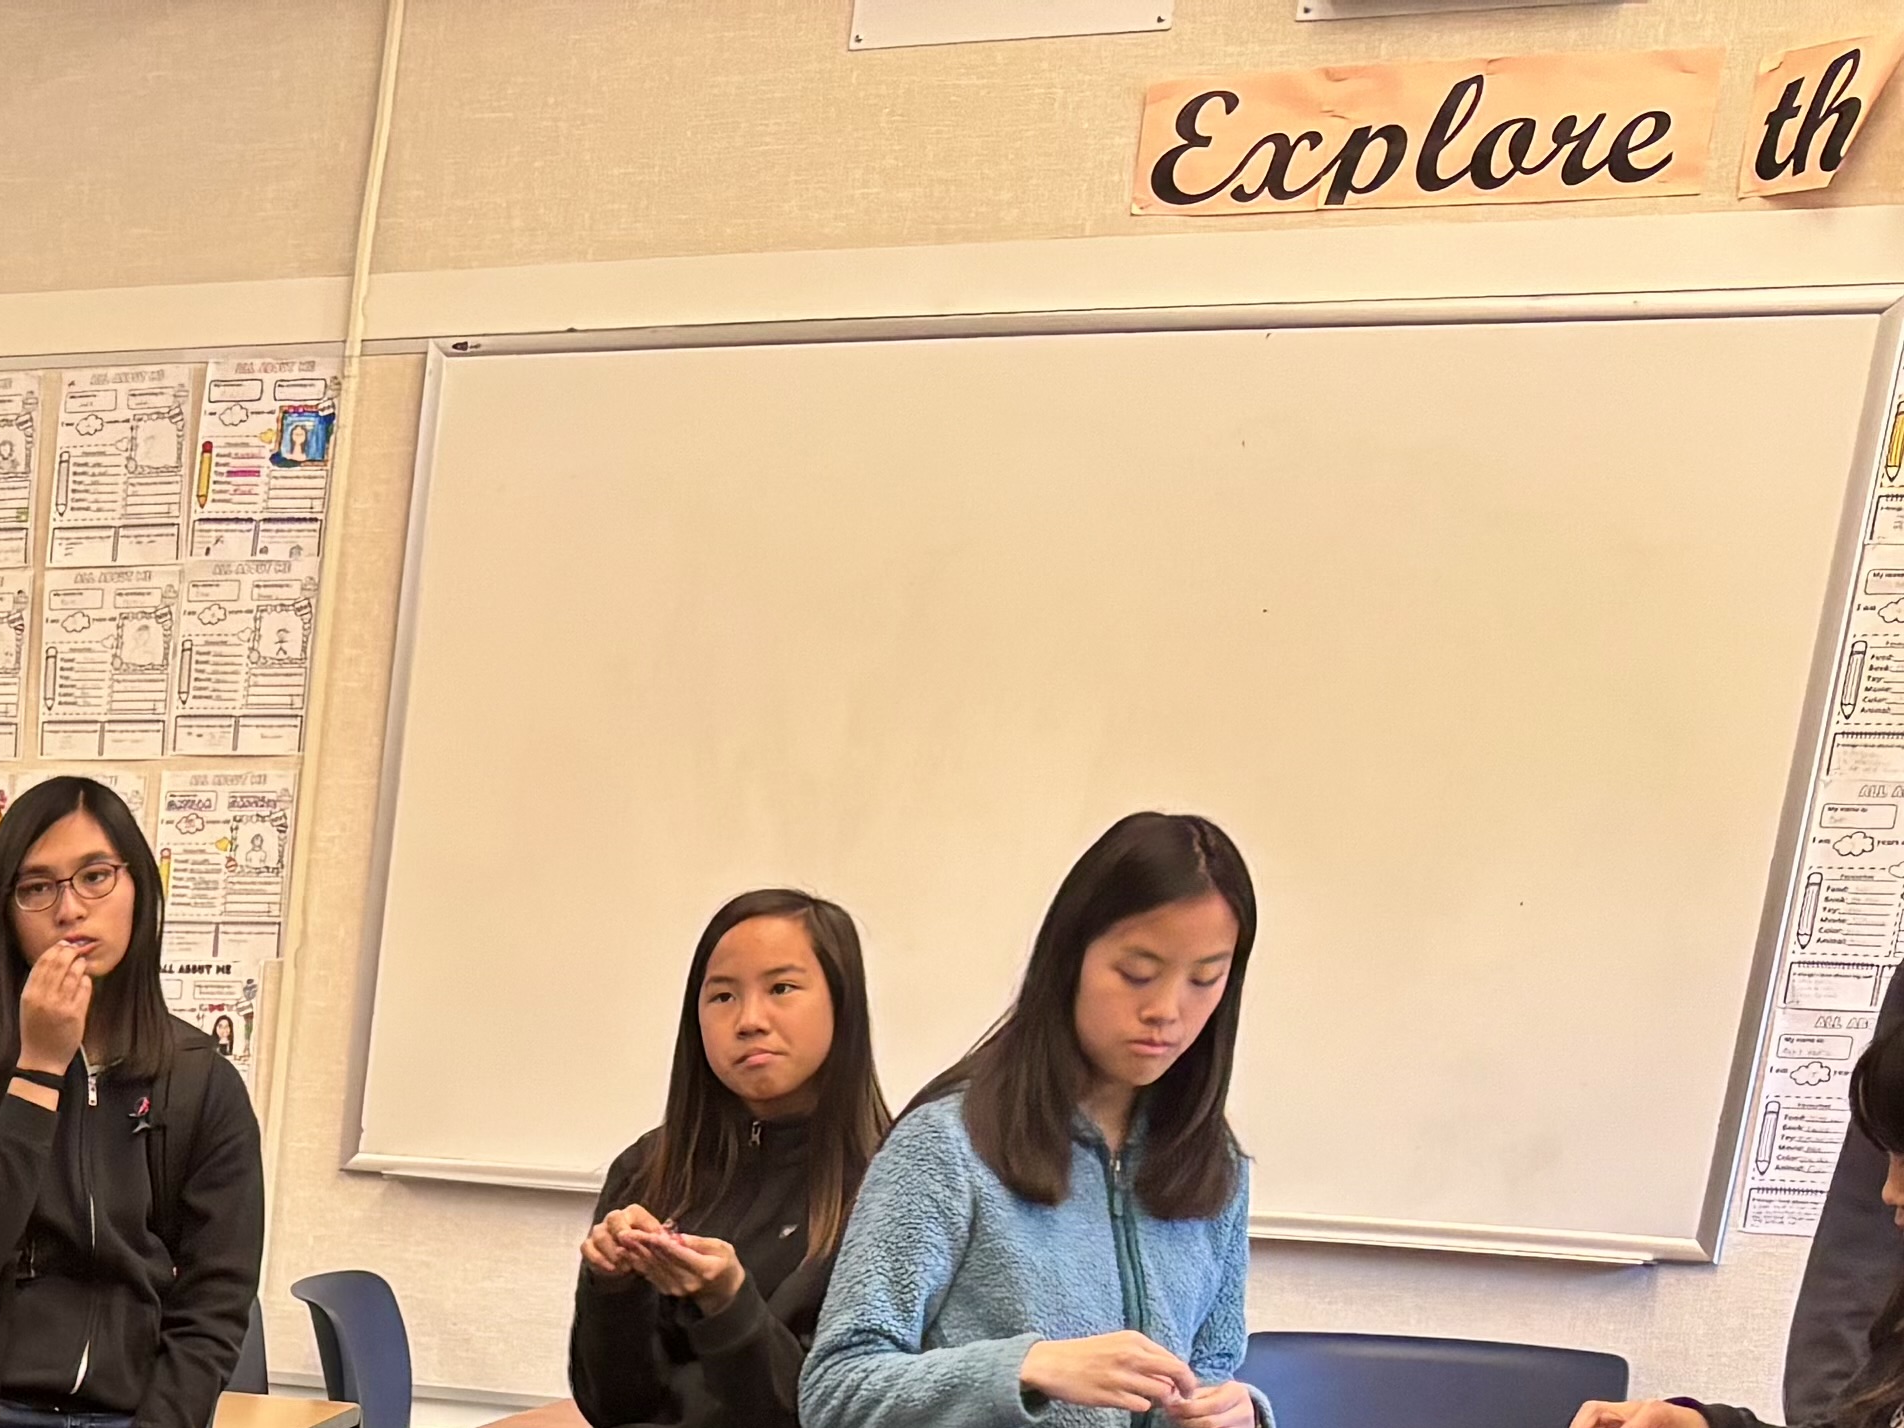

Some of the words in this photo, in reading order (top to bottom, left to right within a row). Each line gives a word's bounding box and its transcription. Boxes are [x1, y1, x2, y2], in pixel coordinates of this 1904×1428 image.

[1150, 74, 1674, 206] Explore
[178, 964, 213, 975] ABOUT
[215, 964, 232, 976] ME
